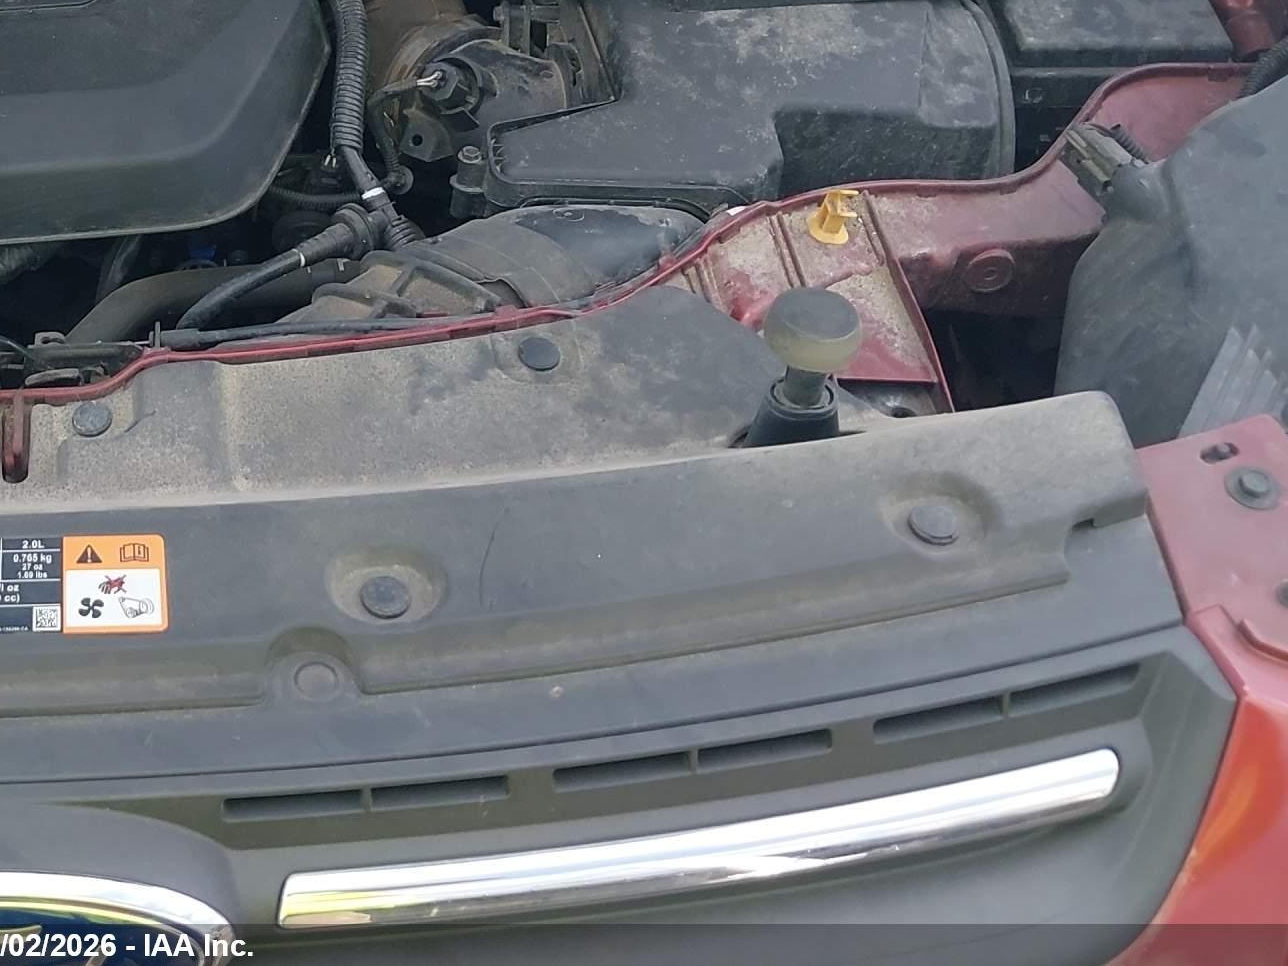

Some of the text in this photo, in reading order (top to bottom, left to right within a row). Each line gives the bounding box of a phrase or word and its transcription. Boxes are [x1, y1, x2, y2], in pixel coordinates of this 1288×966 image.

[21, 539, 45, 549] 2.0L
[39, 552, 52, 564] kg
[21, 563, 31, 571] 27
[35, 570, 48, 579] lbs
[6, 584, 20, 593] oz
[3, 592, 21, 603] cc)
